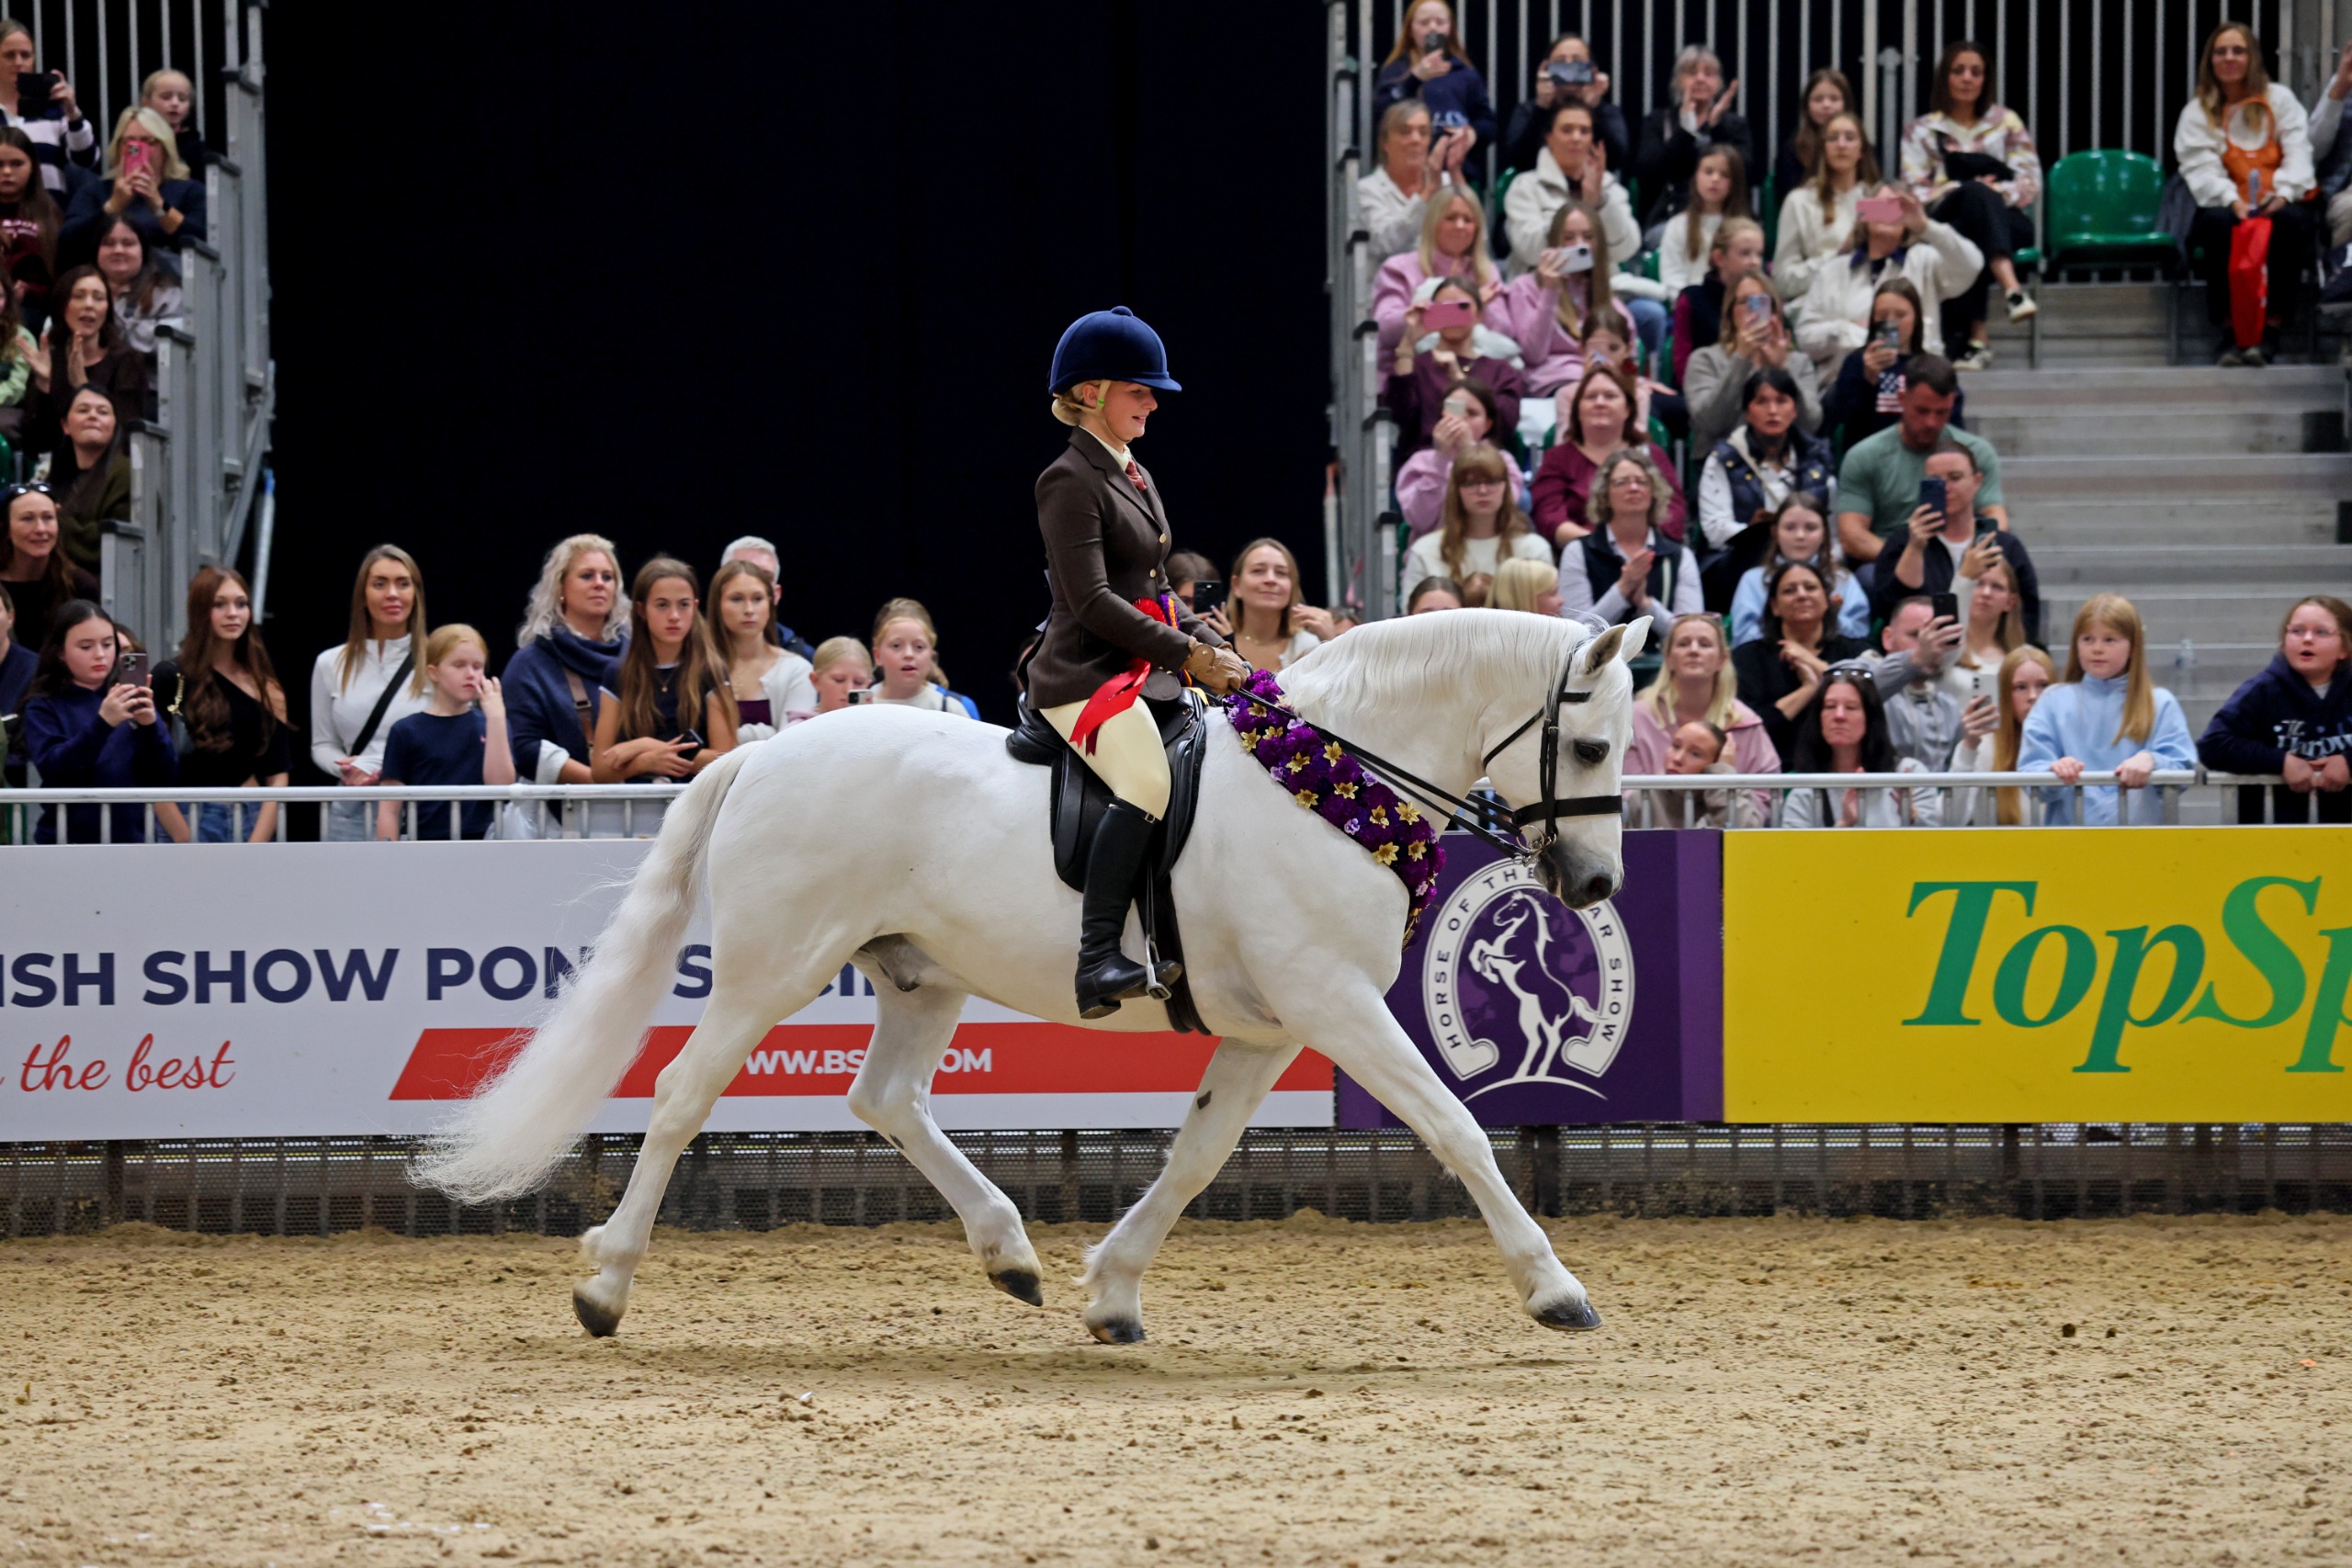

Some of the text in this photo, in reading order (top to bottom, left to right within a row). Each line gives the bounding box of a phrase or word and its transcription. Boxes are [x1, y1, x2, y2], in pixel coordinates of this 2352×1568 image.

[0, 945, 595, 1008] SH SHOW PON
[1435, 867, 1623, 1049] HORSE OF THE AR SHOW
[20, 1032, 236, 1092] the best
